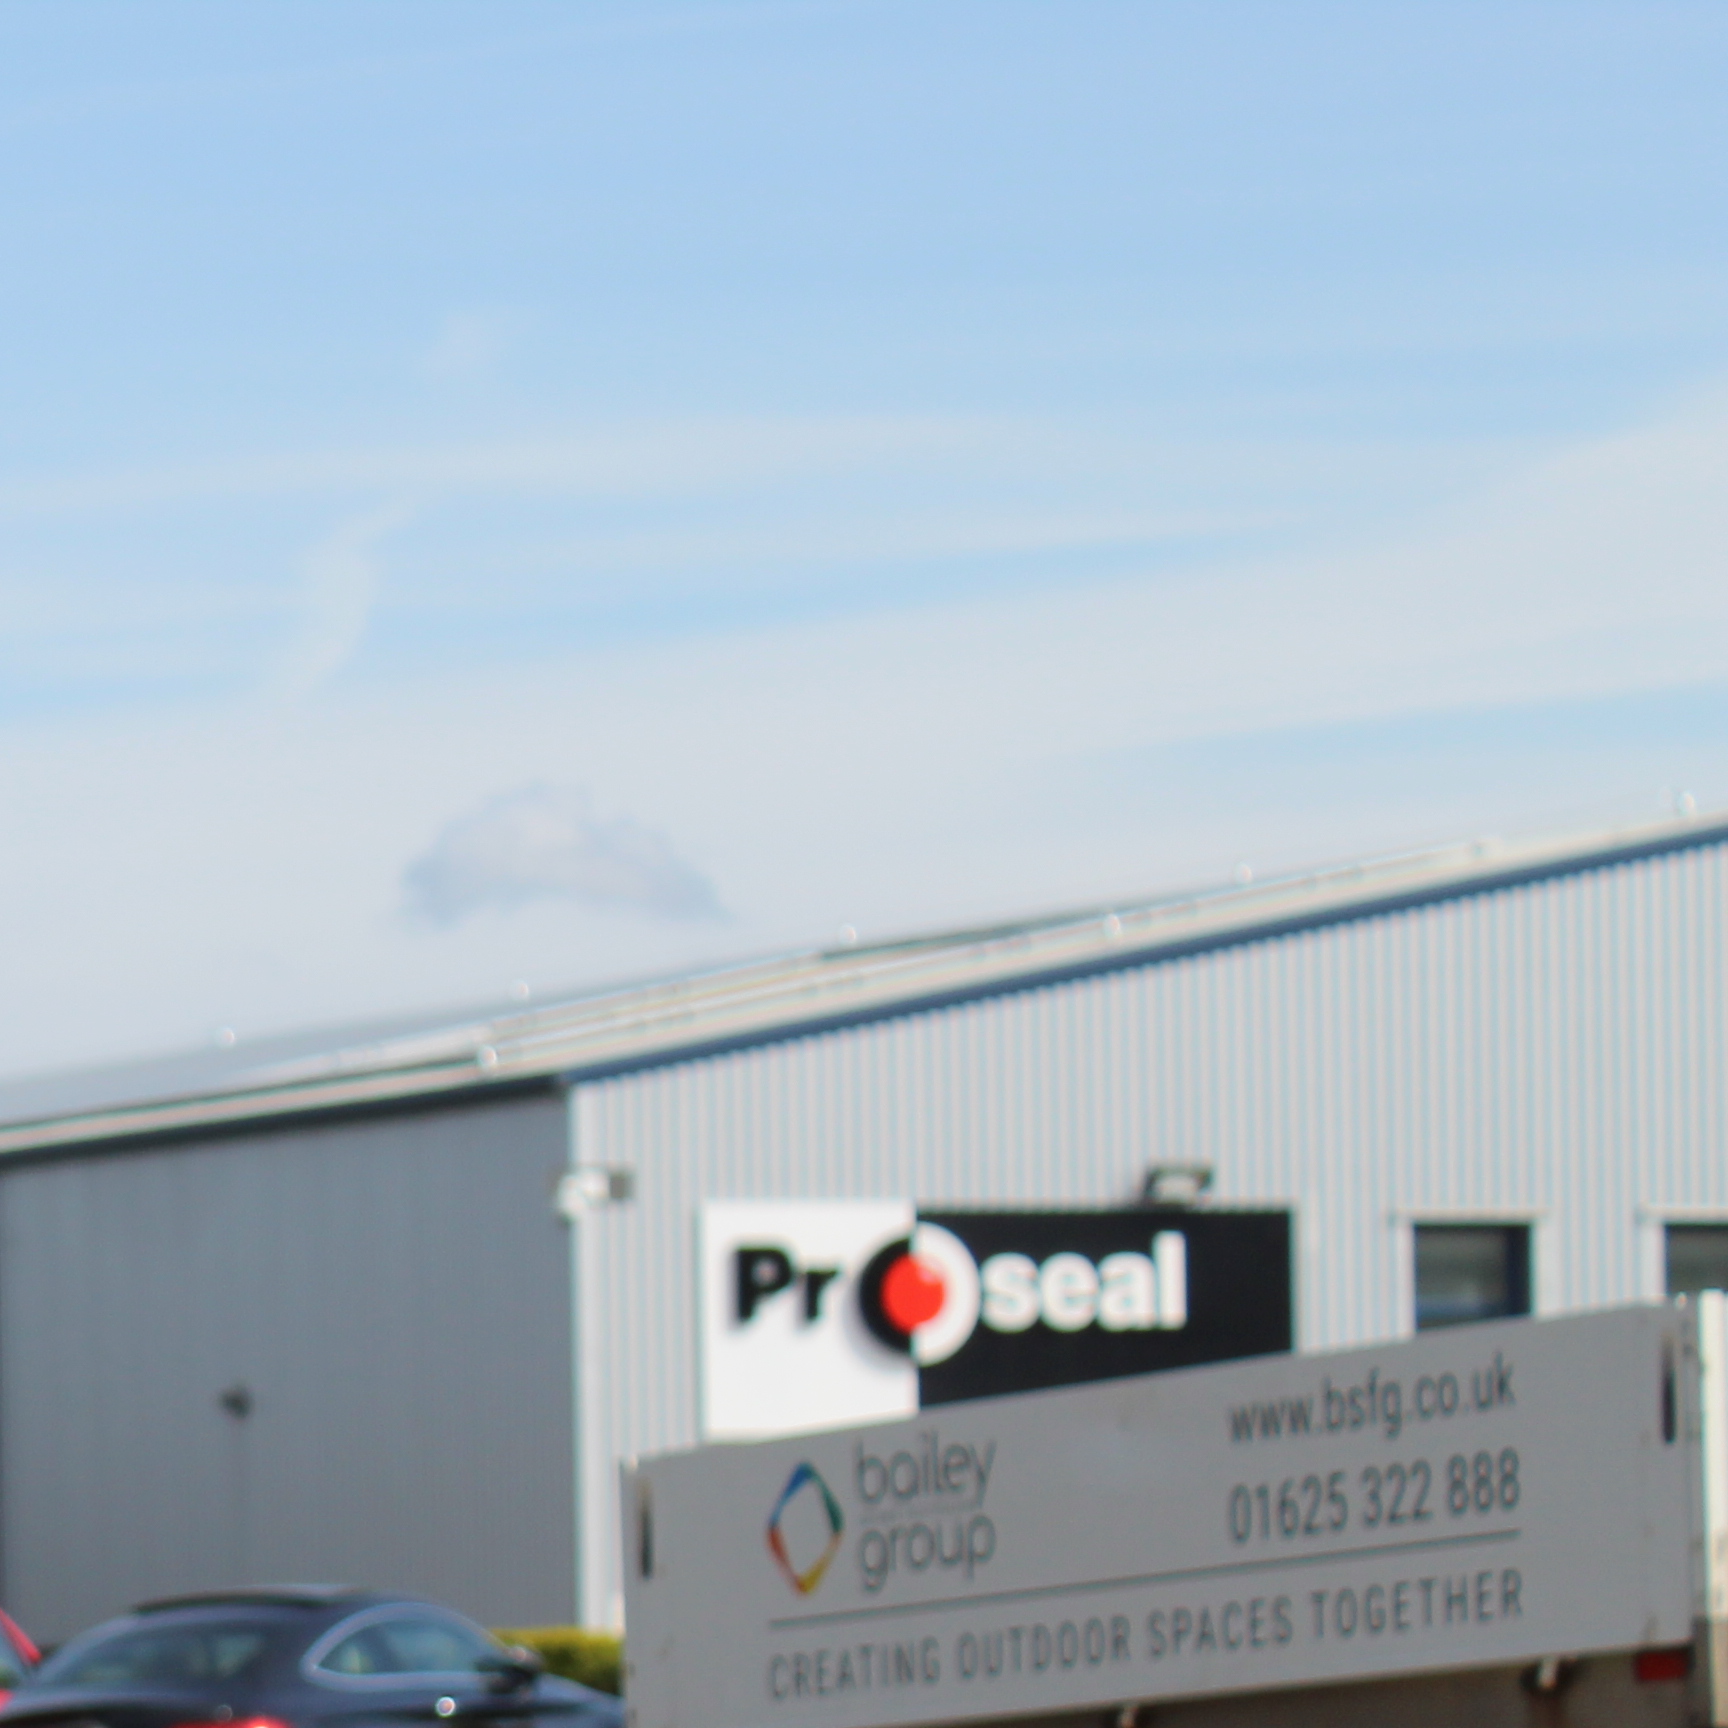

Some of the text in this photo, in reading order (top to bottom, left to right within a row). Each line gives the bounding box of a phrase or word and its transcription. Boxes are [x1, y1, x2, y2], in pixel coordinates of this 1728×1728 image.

[1229, 1351, 1516, 1443] www.bsfg.co.uk
[854, 1430, 997, 1509] bailey
[1229, 1446, 1521, 1544] 01625 322 888
[859, 1513, 998, 1594] group
[769, 1567, 1524, 1701] CREATING OUTDOOR SPACES TOGETHER
